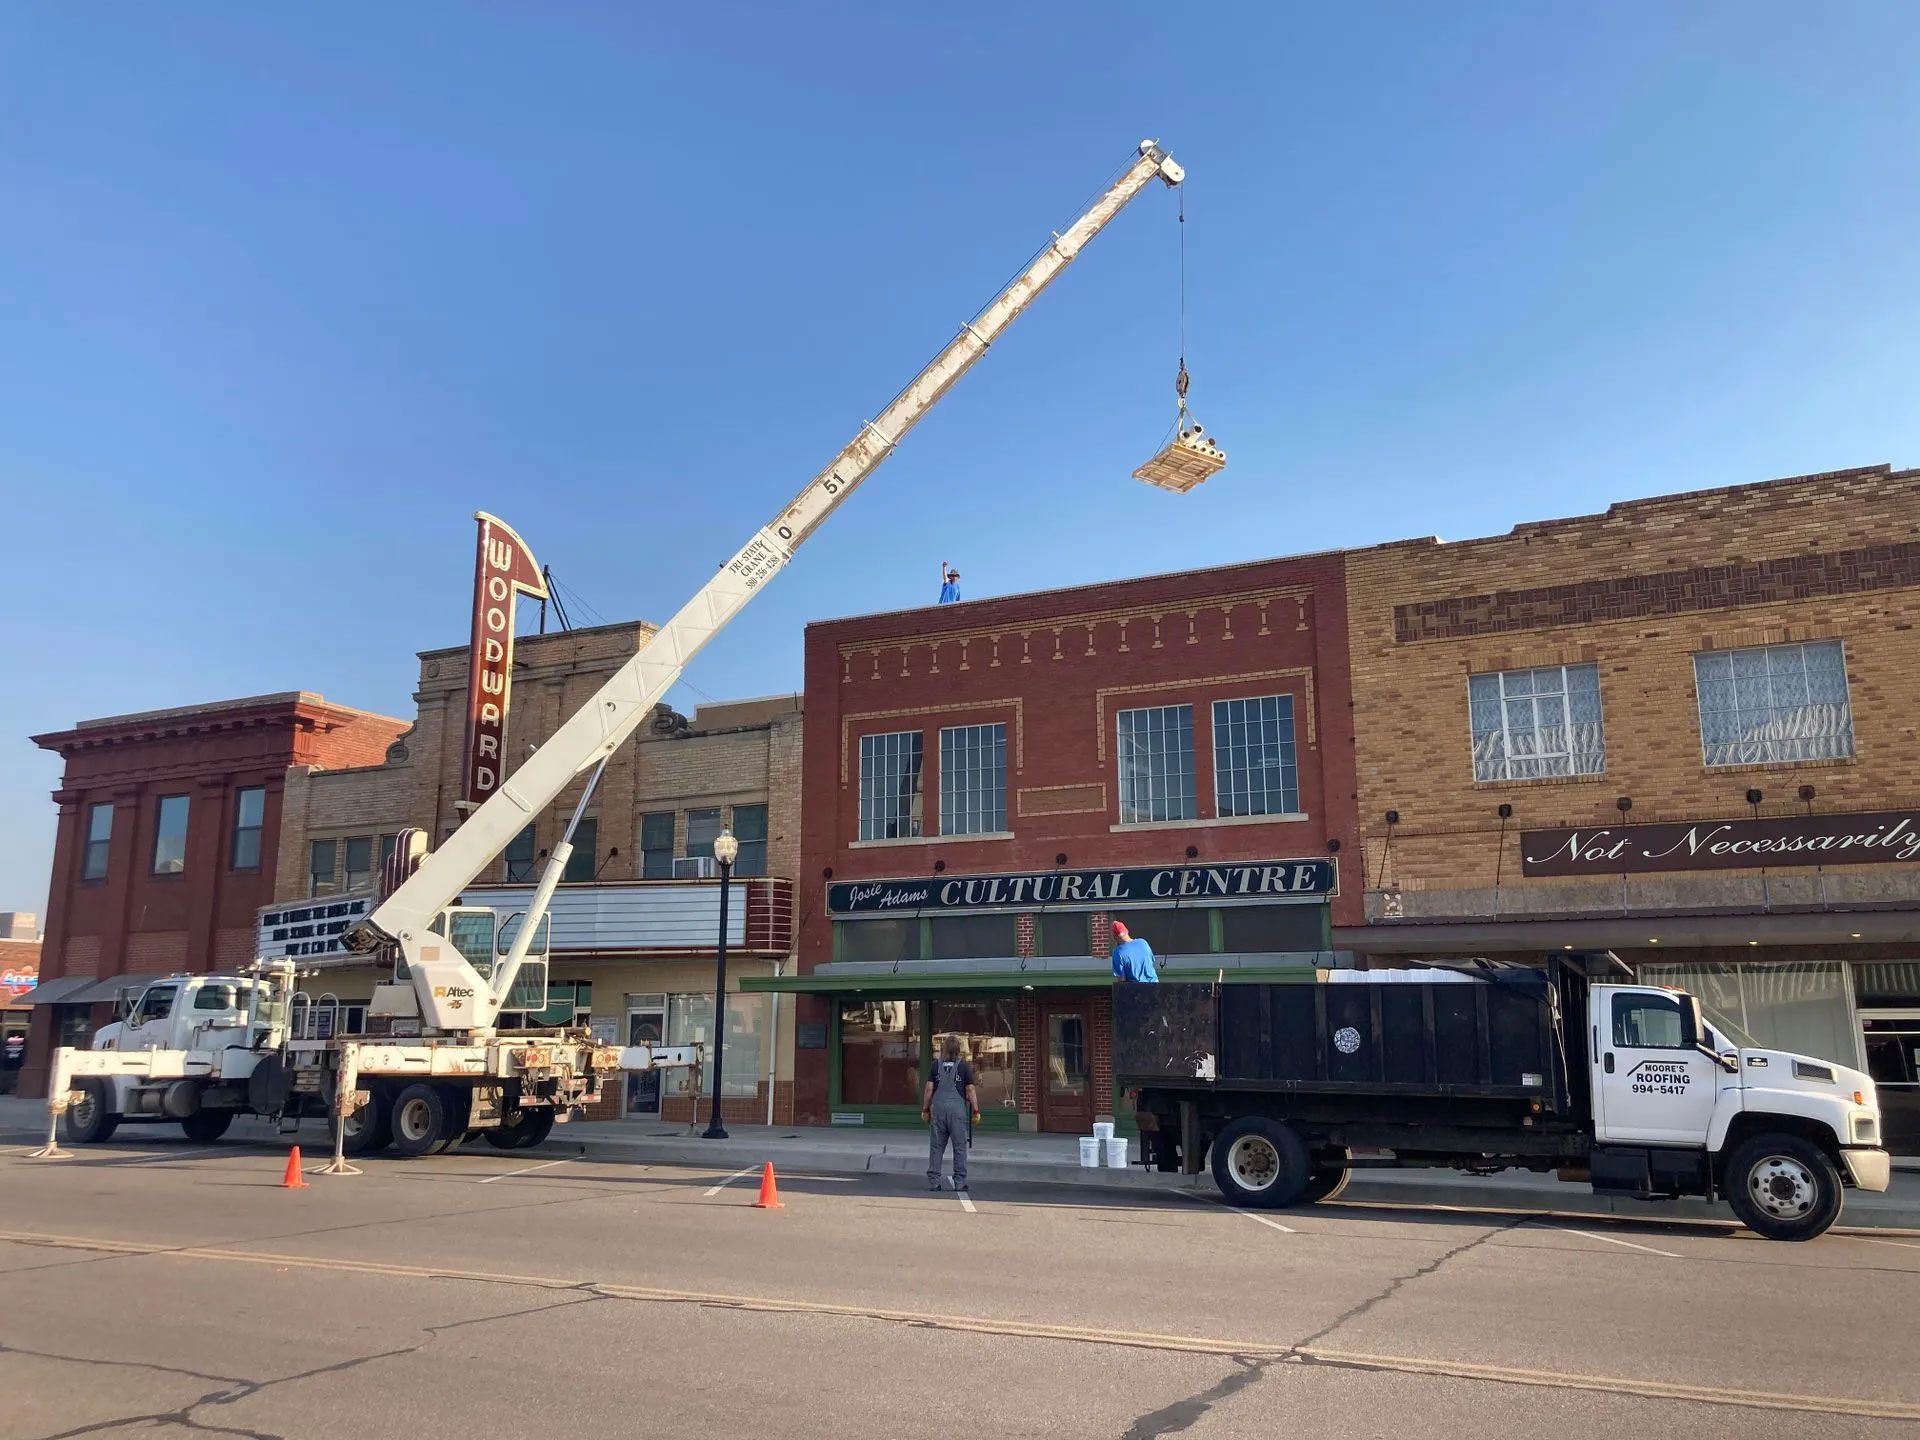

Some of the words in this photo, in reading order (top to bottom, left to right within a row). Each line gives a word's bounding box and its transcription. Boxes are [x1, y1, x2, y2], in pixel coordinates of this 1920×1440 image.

[823, 473, 845, 494] 51
[728, 540, 763, 574] TRI-STATE
[740, 551, 767, 577] CRANE
[477, 537, 512, 791] WOODWARD
[1526, 831, 1632, 863] Not
[1643, 818, 1920, 861] Necessarily
[850, 882, 882, 910] Josie
[879, 887, 929, 909] Adams
[940, 872, 1130, 905] CULTURAL
[1150, 864, 1317, 897] CENTRE
[446, 986, 474, 998] Altec
[1636, 1073, 1691, 1084] ROOFING
[1645, 1064, 1685, 1073] MOORE'S
[1632, 1084, 1686, 1095] 994-5417
